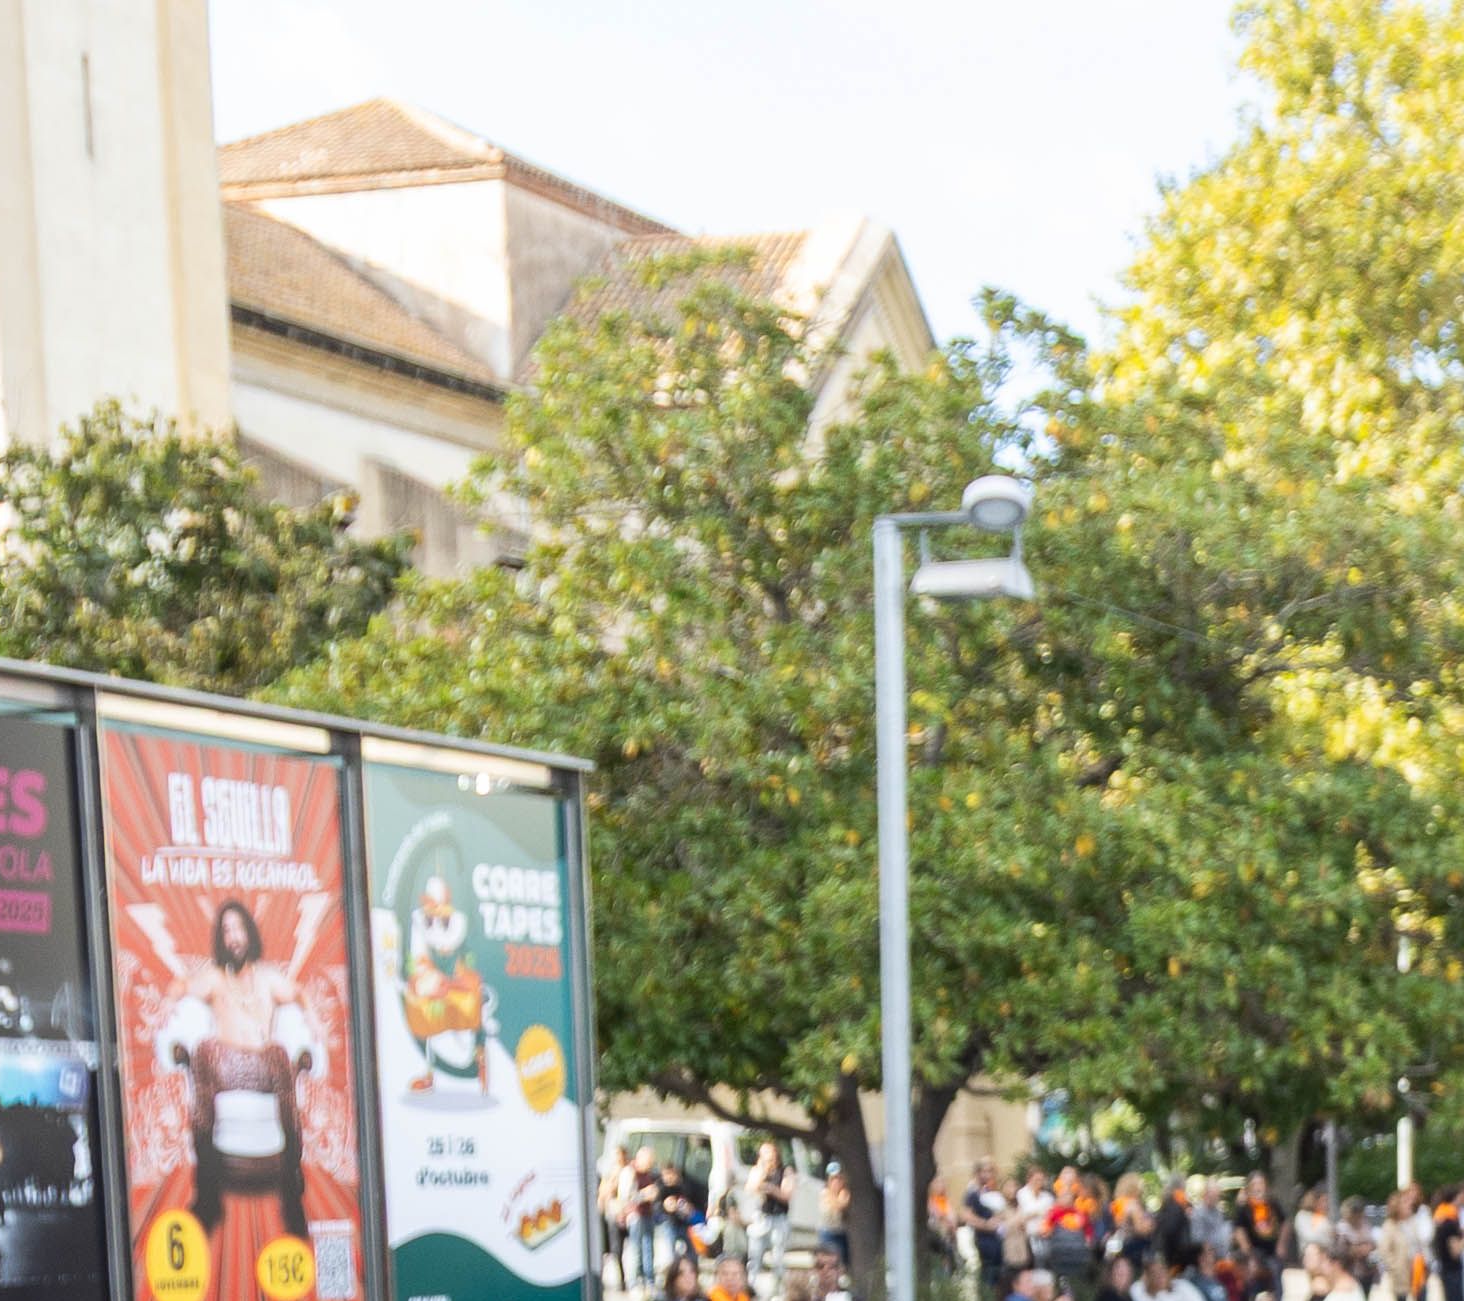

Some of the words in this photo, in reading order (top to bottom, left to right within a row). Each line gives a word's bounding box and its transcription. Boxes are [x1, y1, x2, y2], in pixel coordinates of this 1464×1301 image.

[168, 772, 201, 846] EL
[140, 855, 166, 885] LA
[168, 857, 209, 888] VIDA
[212, 859, 234, 888] ES
[472, 863, 560, 906] CORRE
[479, 902, 563, 946] TAPES
[168, 1222, 186, 1272] 6
